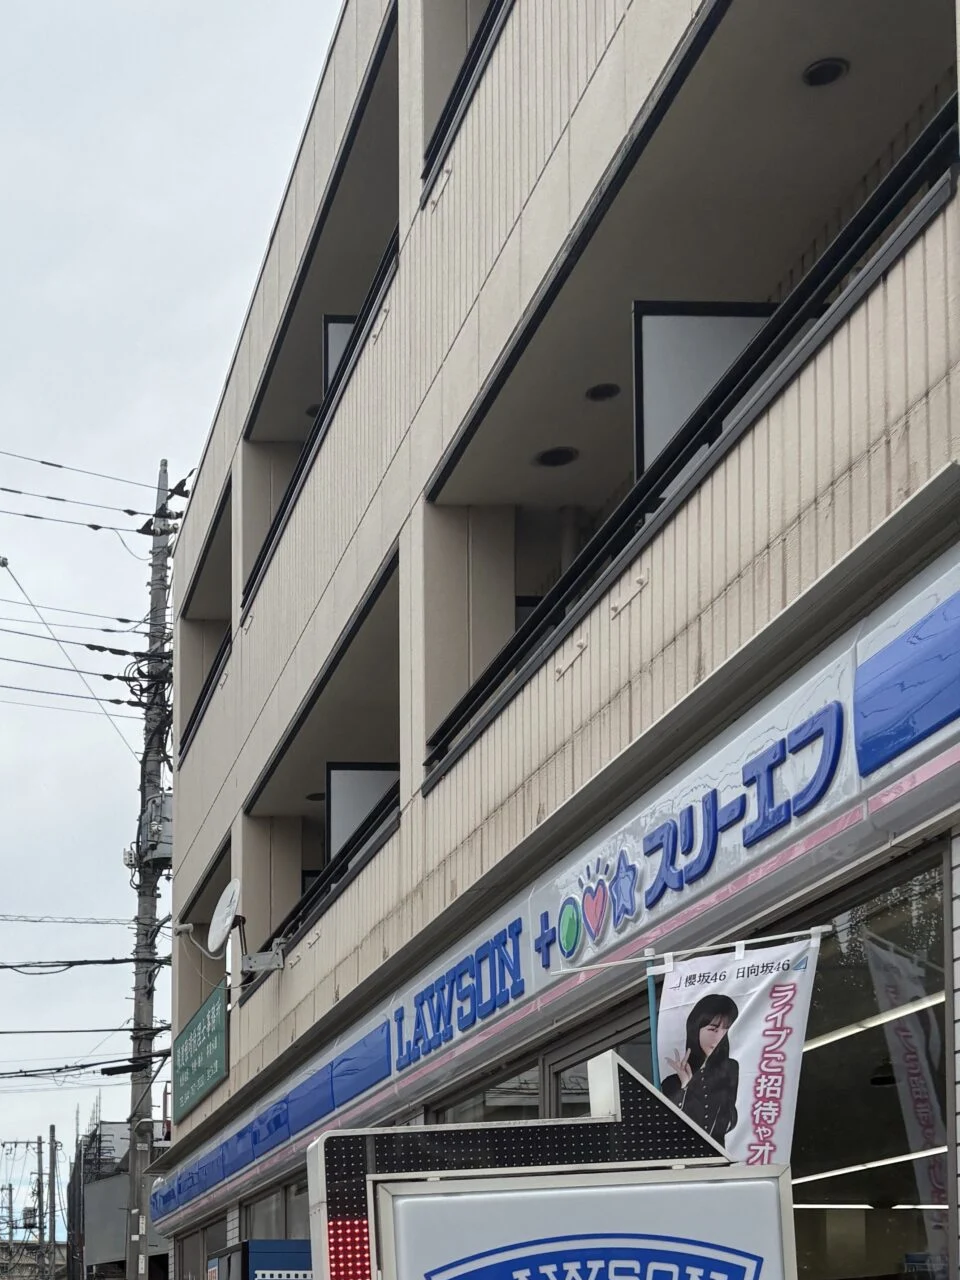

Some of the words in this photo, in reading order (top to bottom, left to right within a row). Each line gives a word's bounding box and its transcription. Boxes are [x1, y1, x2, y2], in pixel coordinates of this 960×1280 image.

[643, 699, 844, 909] スリーエフ
[393, 916, 525, 1073] LAWSON
[684, 970, 727, 987] 櫻坂46
[735, 959, 791, 979] 日向坂46
